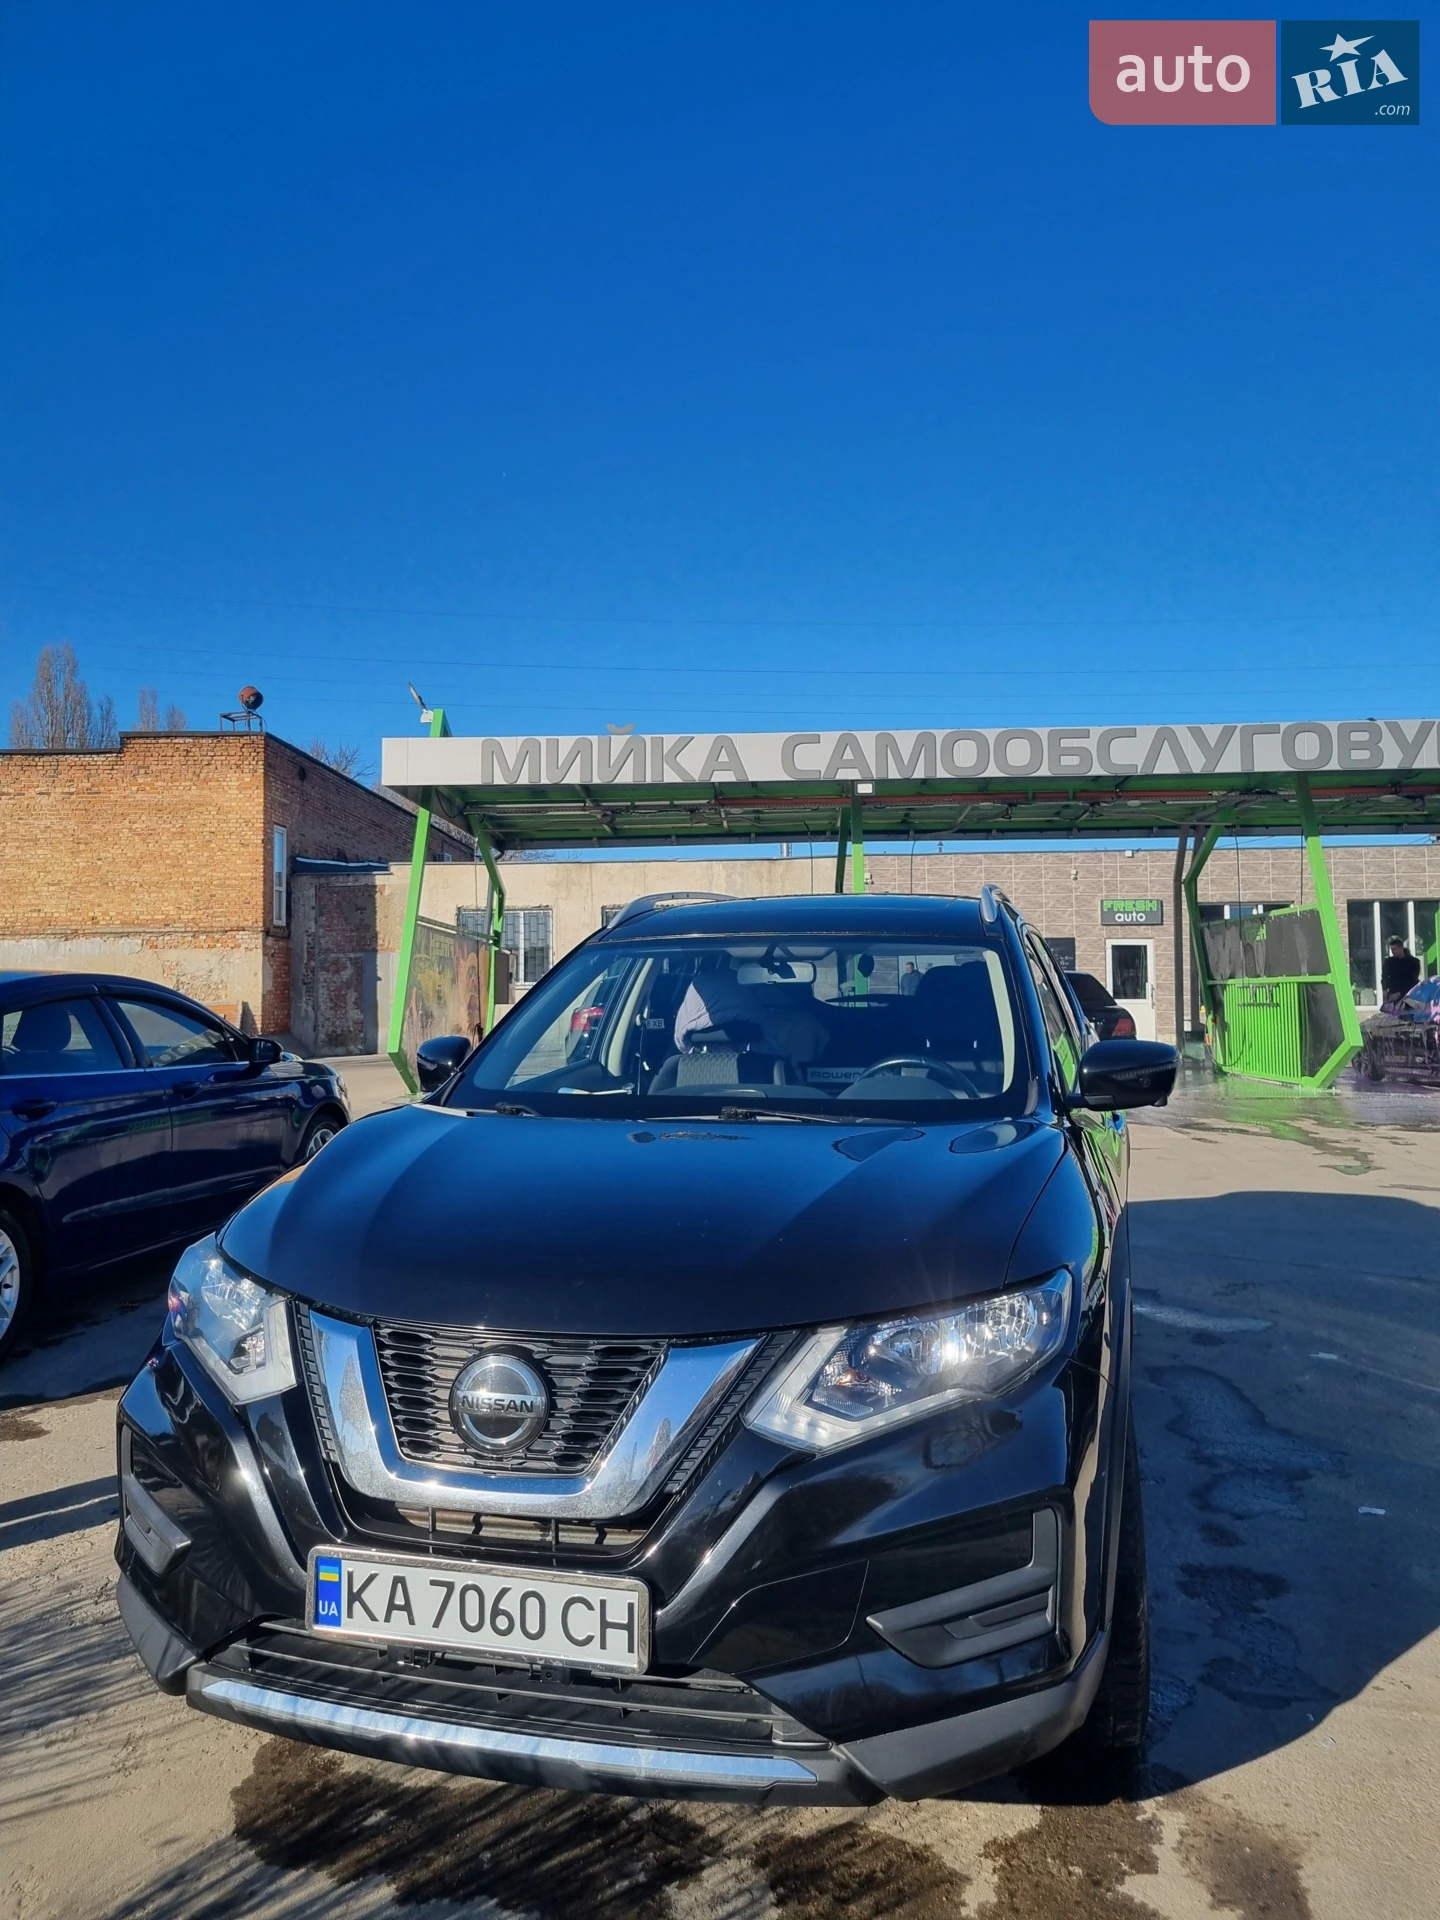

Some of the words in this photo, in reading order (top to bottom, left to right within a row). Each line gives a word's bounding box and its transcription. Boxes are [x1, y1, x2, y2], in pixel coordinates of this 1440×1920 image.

[481, 723, 749, 784] МИЙКА
[781, 720, 1440, 780] САМООБСЛУГОВУ
[1103, 900, 1157, 912] FRESH
[1115, 911, 1146, 922] auto
[462, 1395, 534, 1413] NISSAN
[318, 1599, 339, 1617] UA
[346, 1569, 415, 1626] KA
[429, 1579, 546, 1641] 7060
[561, 1595, 635, 1654] CH
